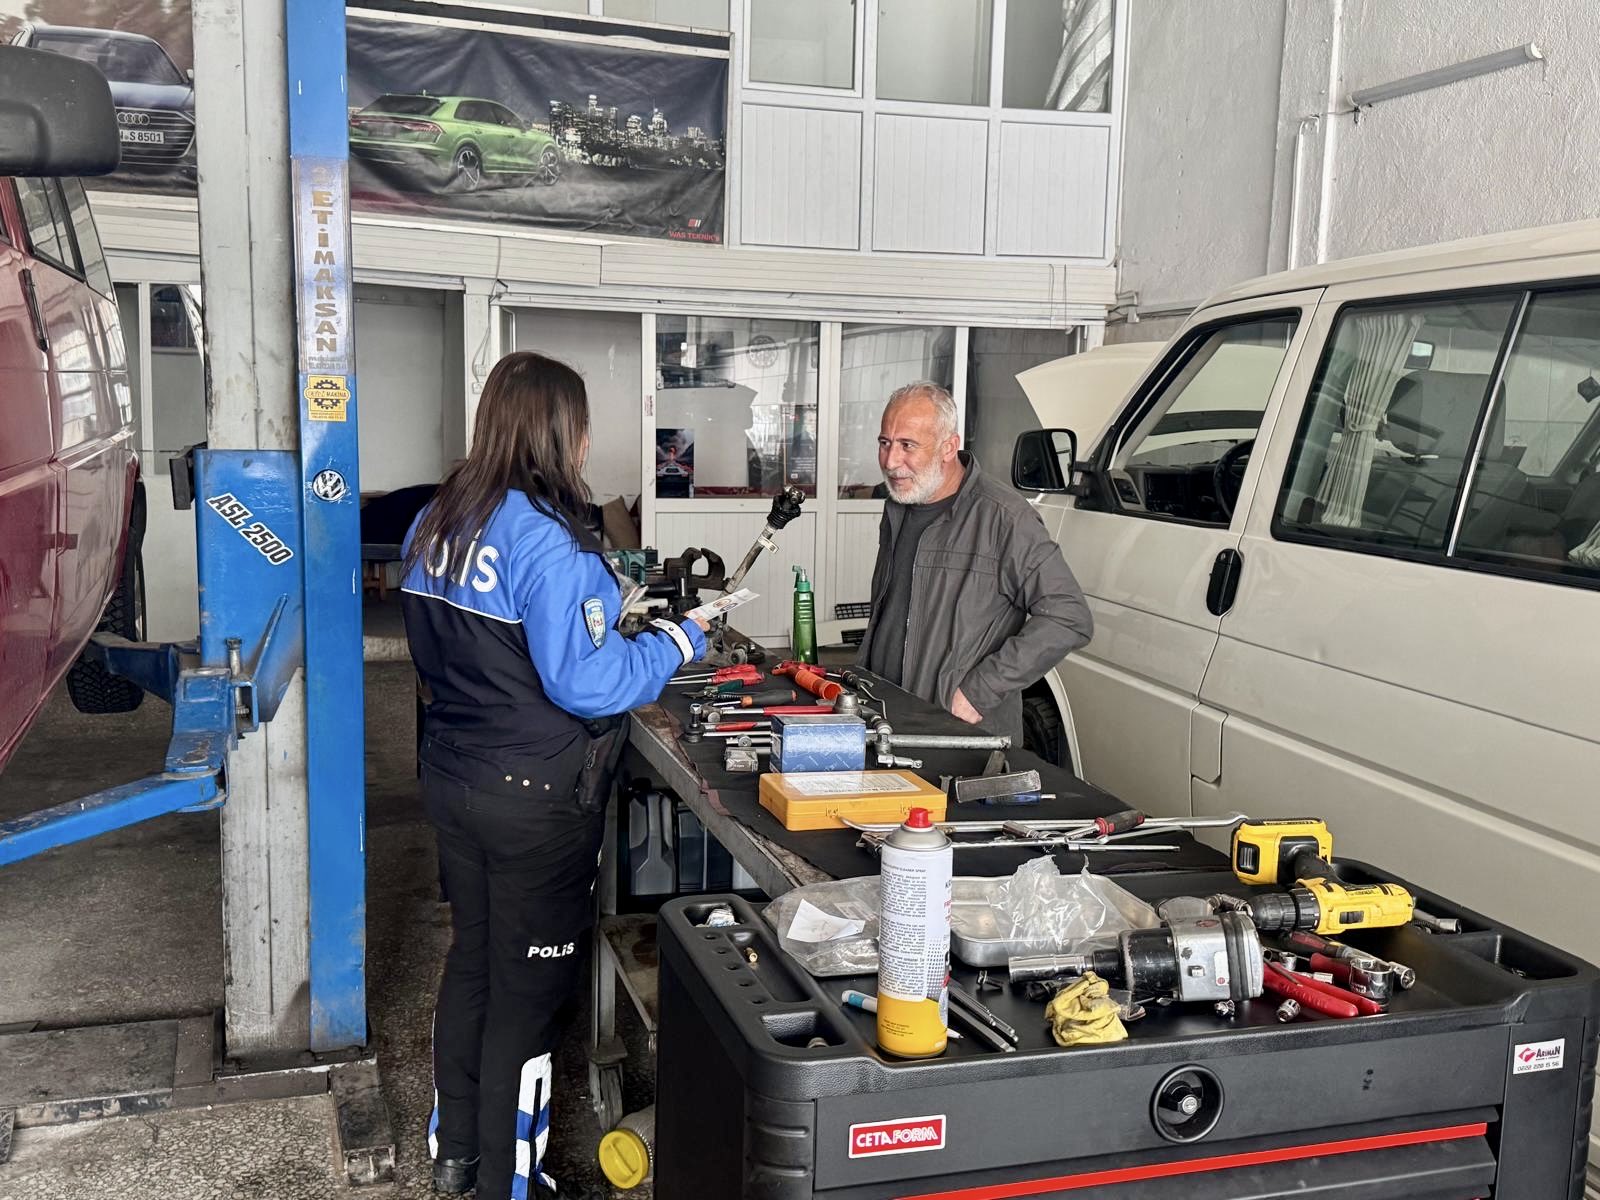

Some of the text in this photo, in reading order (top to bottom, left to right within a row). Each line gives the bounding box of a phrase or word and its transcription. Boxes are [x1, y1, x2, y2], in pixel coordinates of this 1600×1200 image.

[137, 132, 162, 143] 8501
[209, 495, 293, 564] ASL 2500
